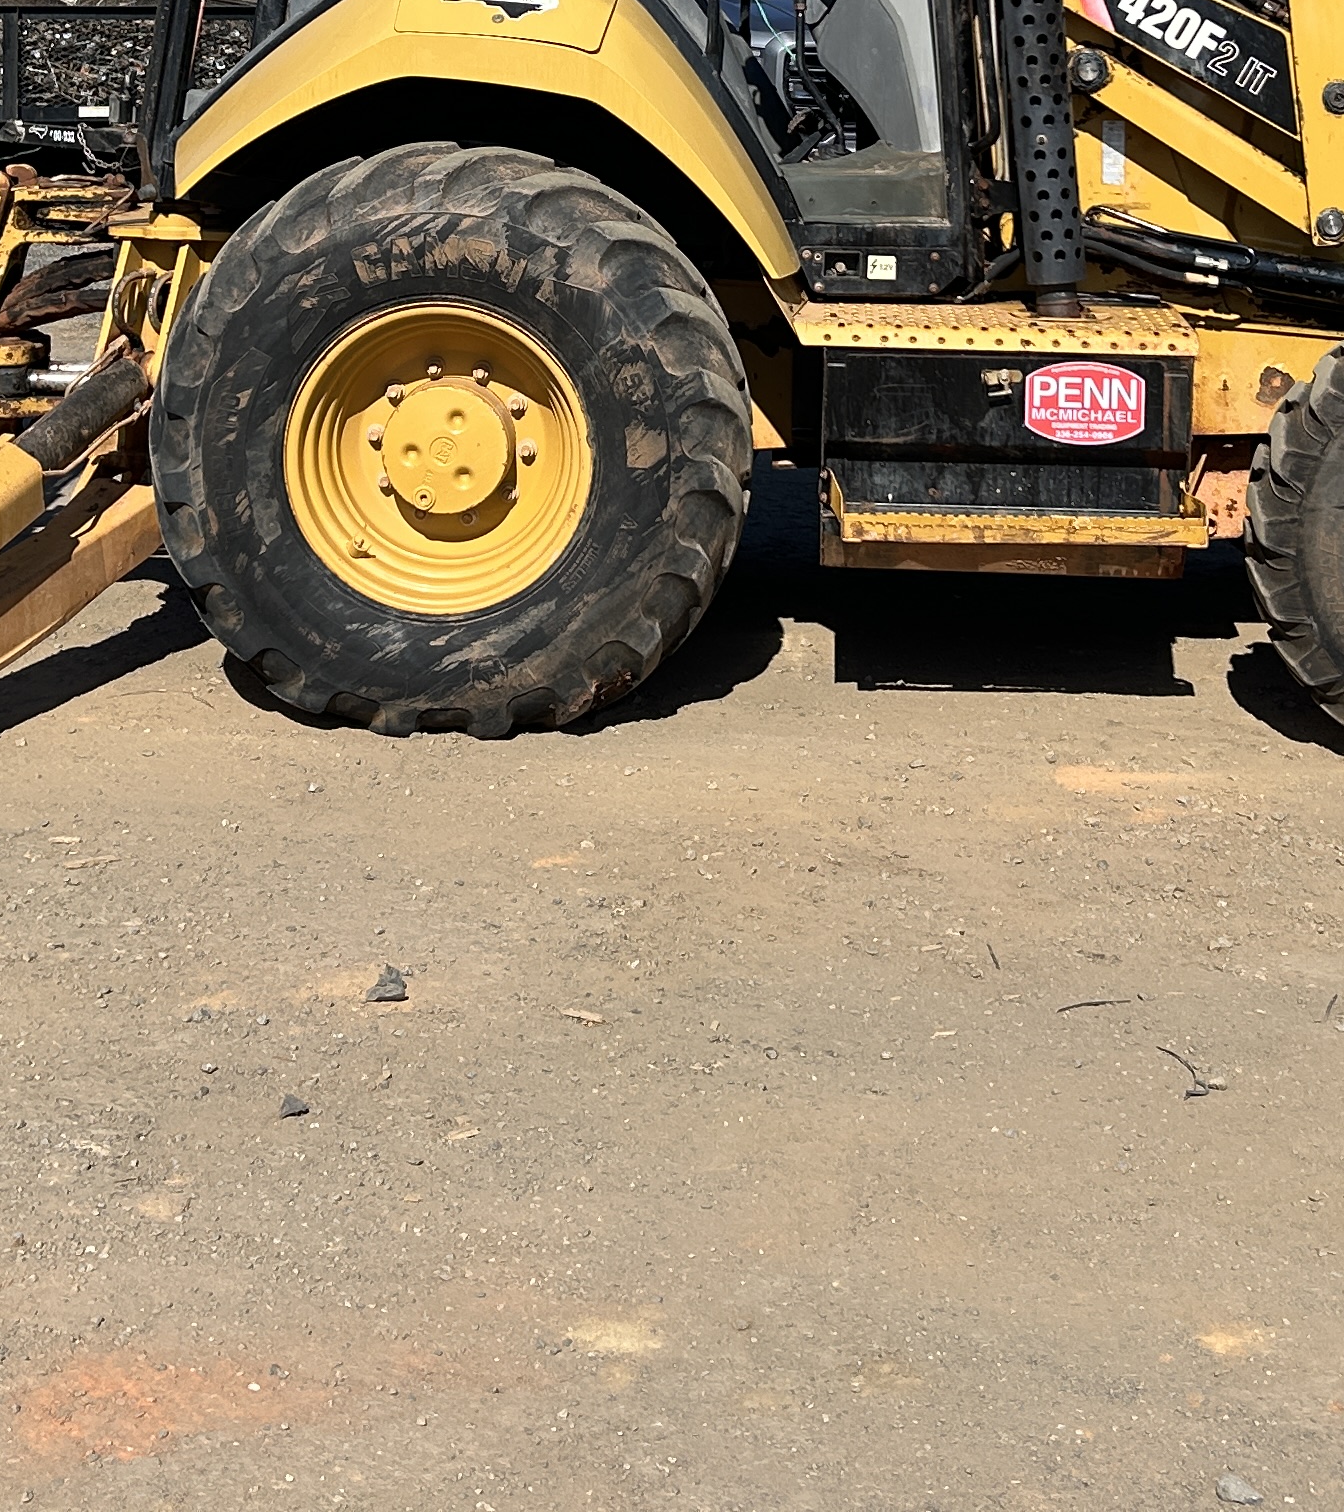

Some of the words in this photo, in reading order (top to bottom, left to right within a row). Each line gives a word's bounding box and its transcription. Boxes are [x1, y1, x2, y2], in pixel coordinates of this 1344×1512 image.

[1235, 56, 1279, 96] IT
[1032, 375, 1138, 411] PENN
[1031, 407, 1138, 424] MCMICHAEL
